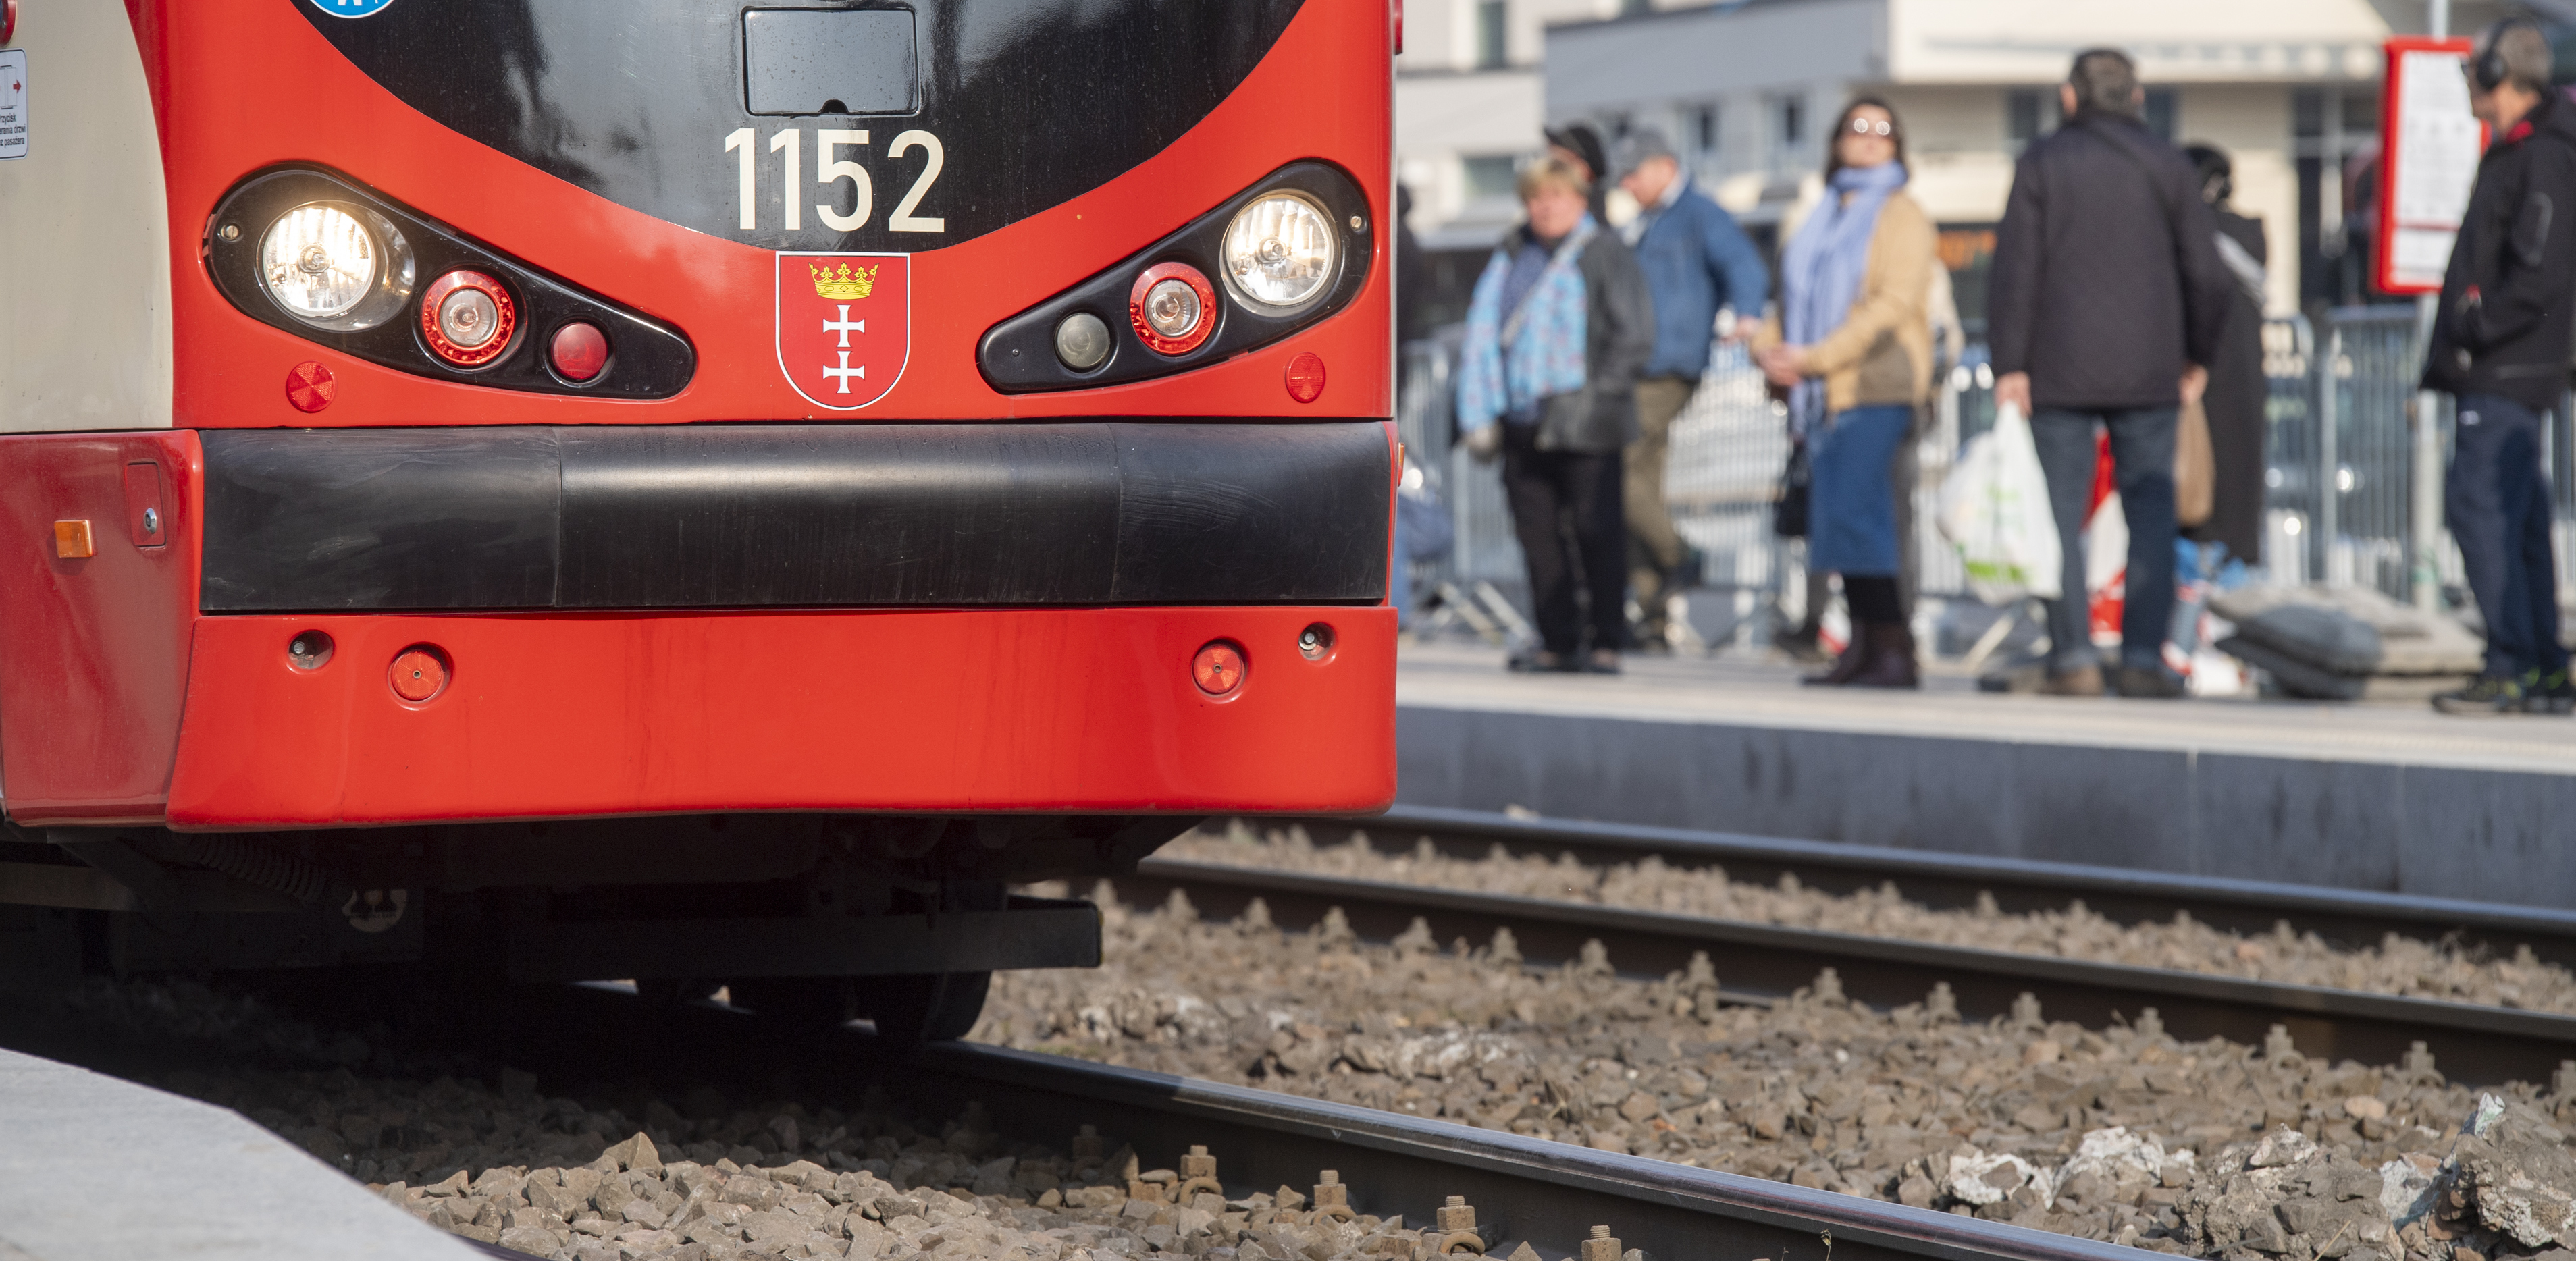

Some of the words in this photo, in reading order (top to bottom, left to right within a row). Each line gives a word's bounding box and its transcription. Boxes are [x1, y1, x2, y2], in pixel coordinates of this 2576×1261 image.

[0, 113, 16, 125] rzycisk
[14, 124, 26, 134] drzwi
[4, 136, 24, 149] pasażera
[725, 128, 945, 233] 1152
